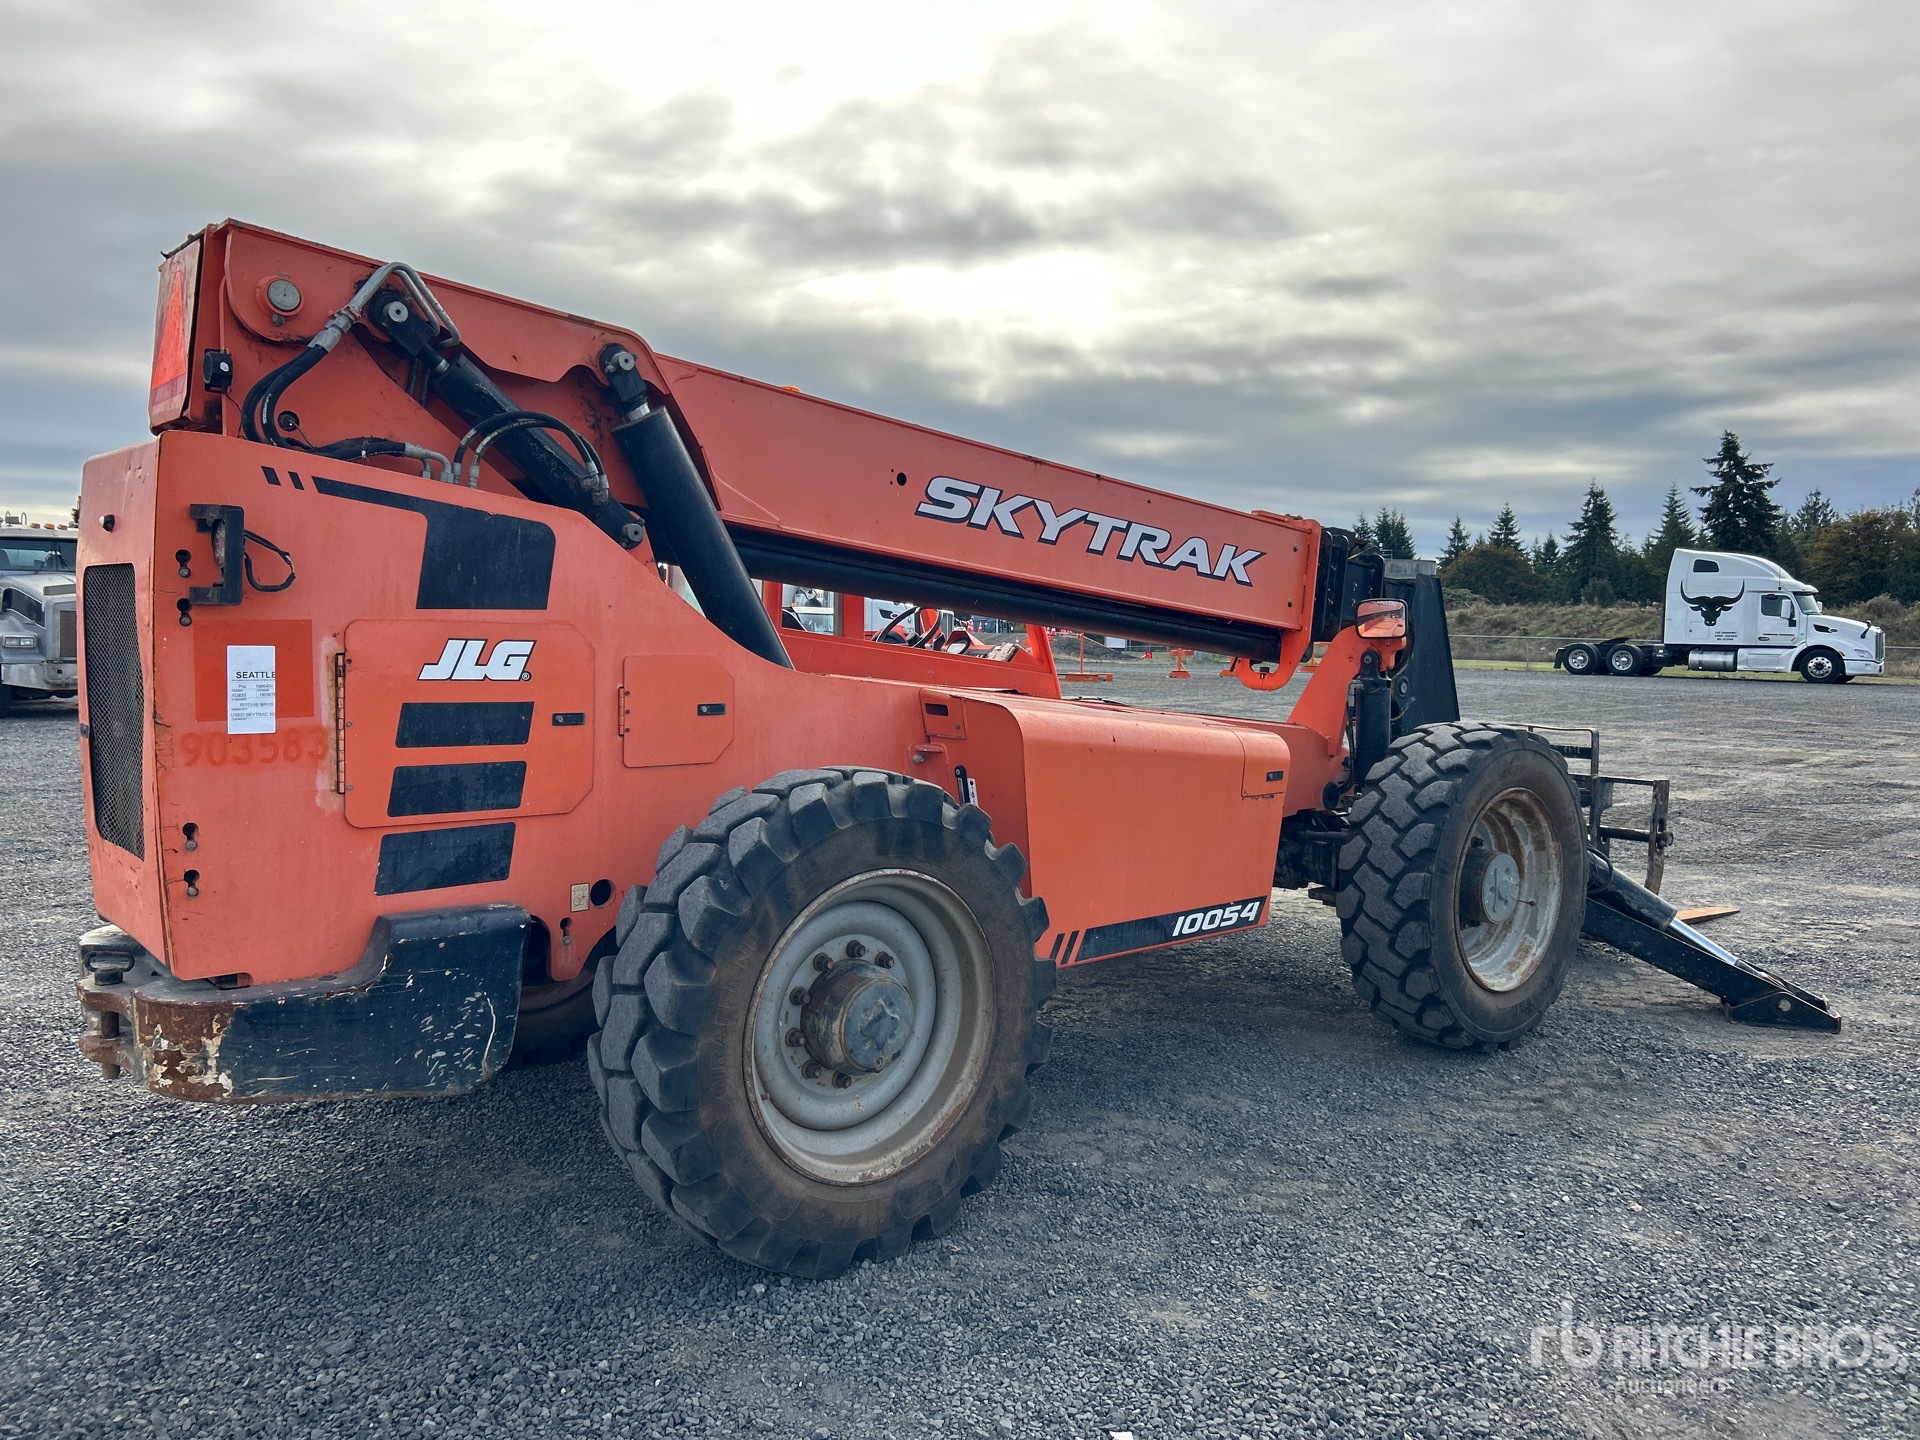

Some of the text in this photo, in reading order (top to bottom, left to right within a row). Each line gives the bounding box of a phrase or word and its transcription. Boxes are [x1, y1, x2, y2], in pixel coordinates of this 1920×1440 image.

[914, 475, 1267, 587] SKYTRAK
[236, 671, 276, 679] SEATTLE
[181, 726, 329, 768] 903583
[1172, 902, 1260, 937] 10054
